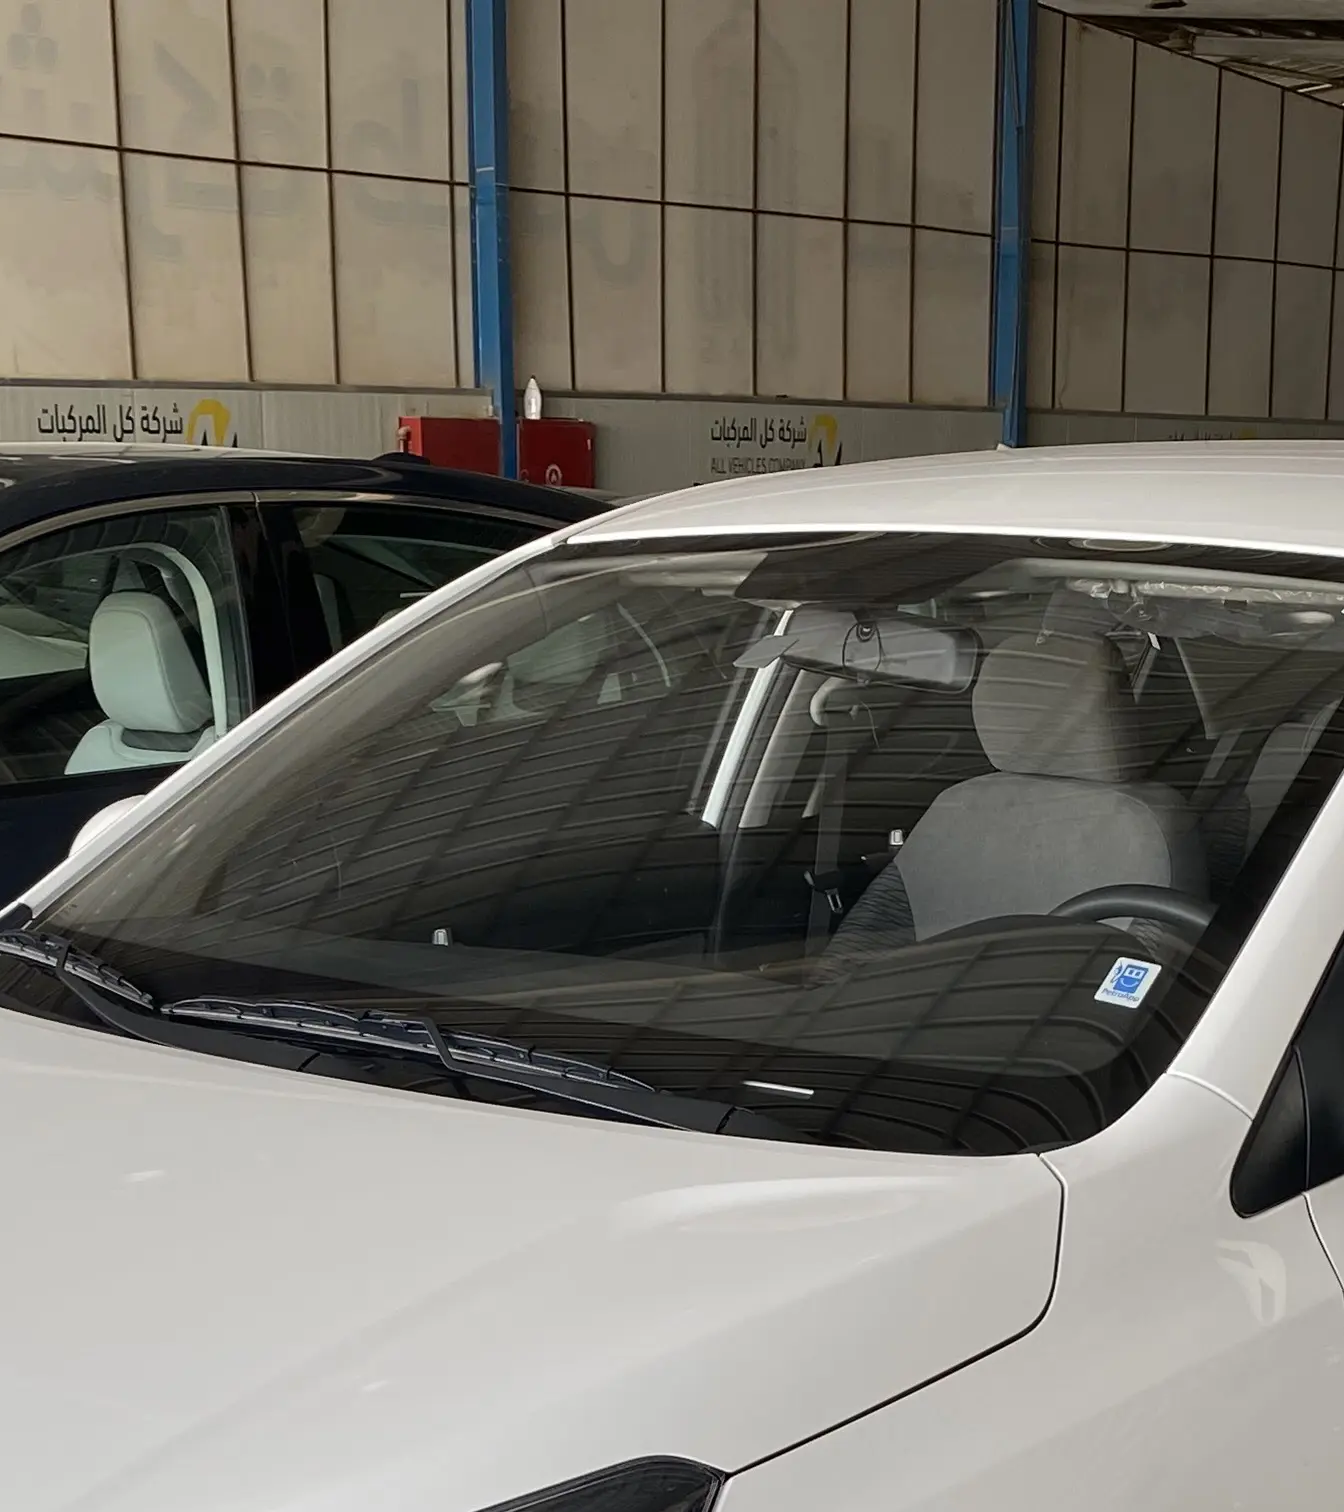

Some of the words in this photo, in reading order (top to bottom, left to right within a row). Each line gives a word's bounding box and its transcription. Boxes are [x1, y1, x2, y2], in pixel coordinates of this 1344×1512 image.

[37, 403, 108, 442] المركبات
[113, 404, 136, 443] كل
[140, 402, 184, 444] شركة
[710, 416, 757, 449] المركبات
[759, 417, 775, 450] كل
[778, 415, 807, 450] شركة
